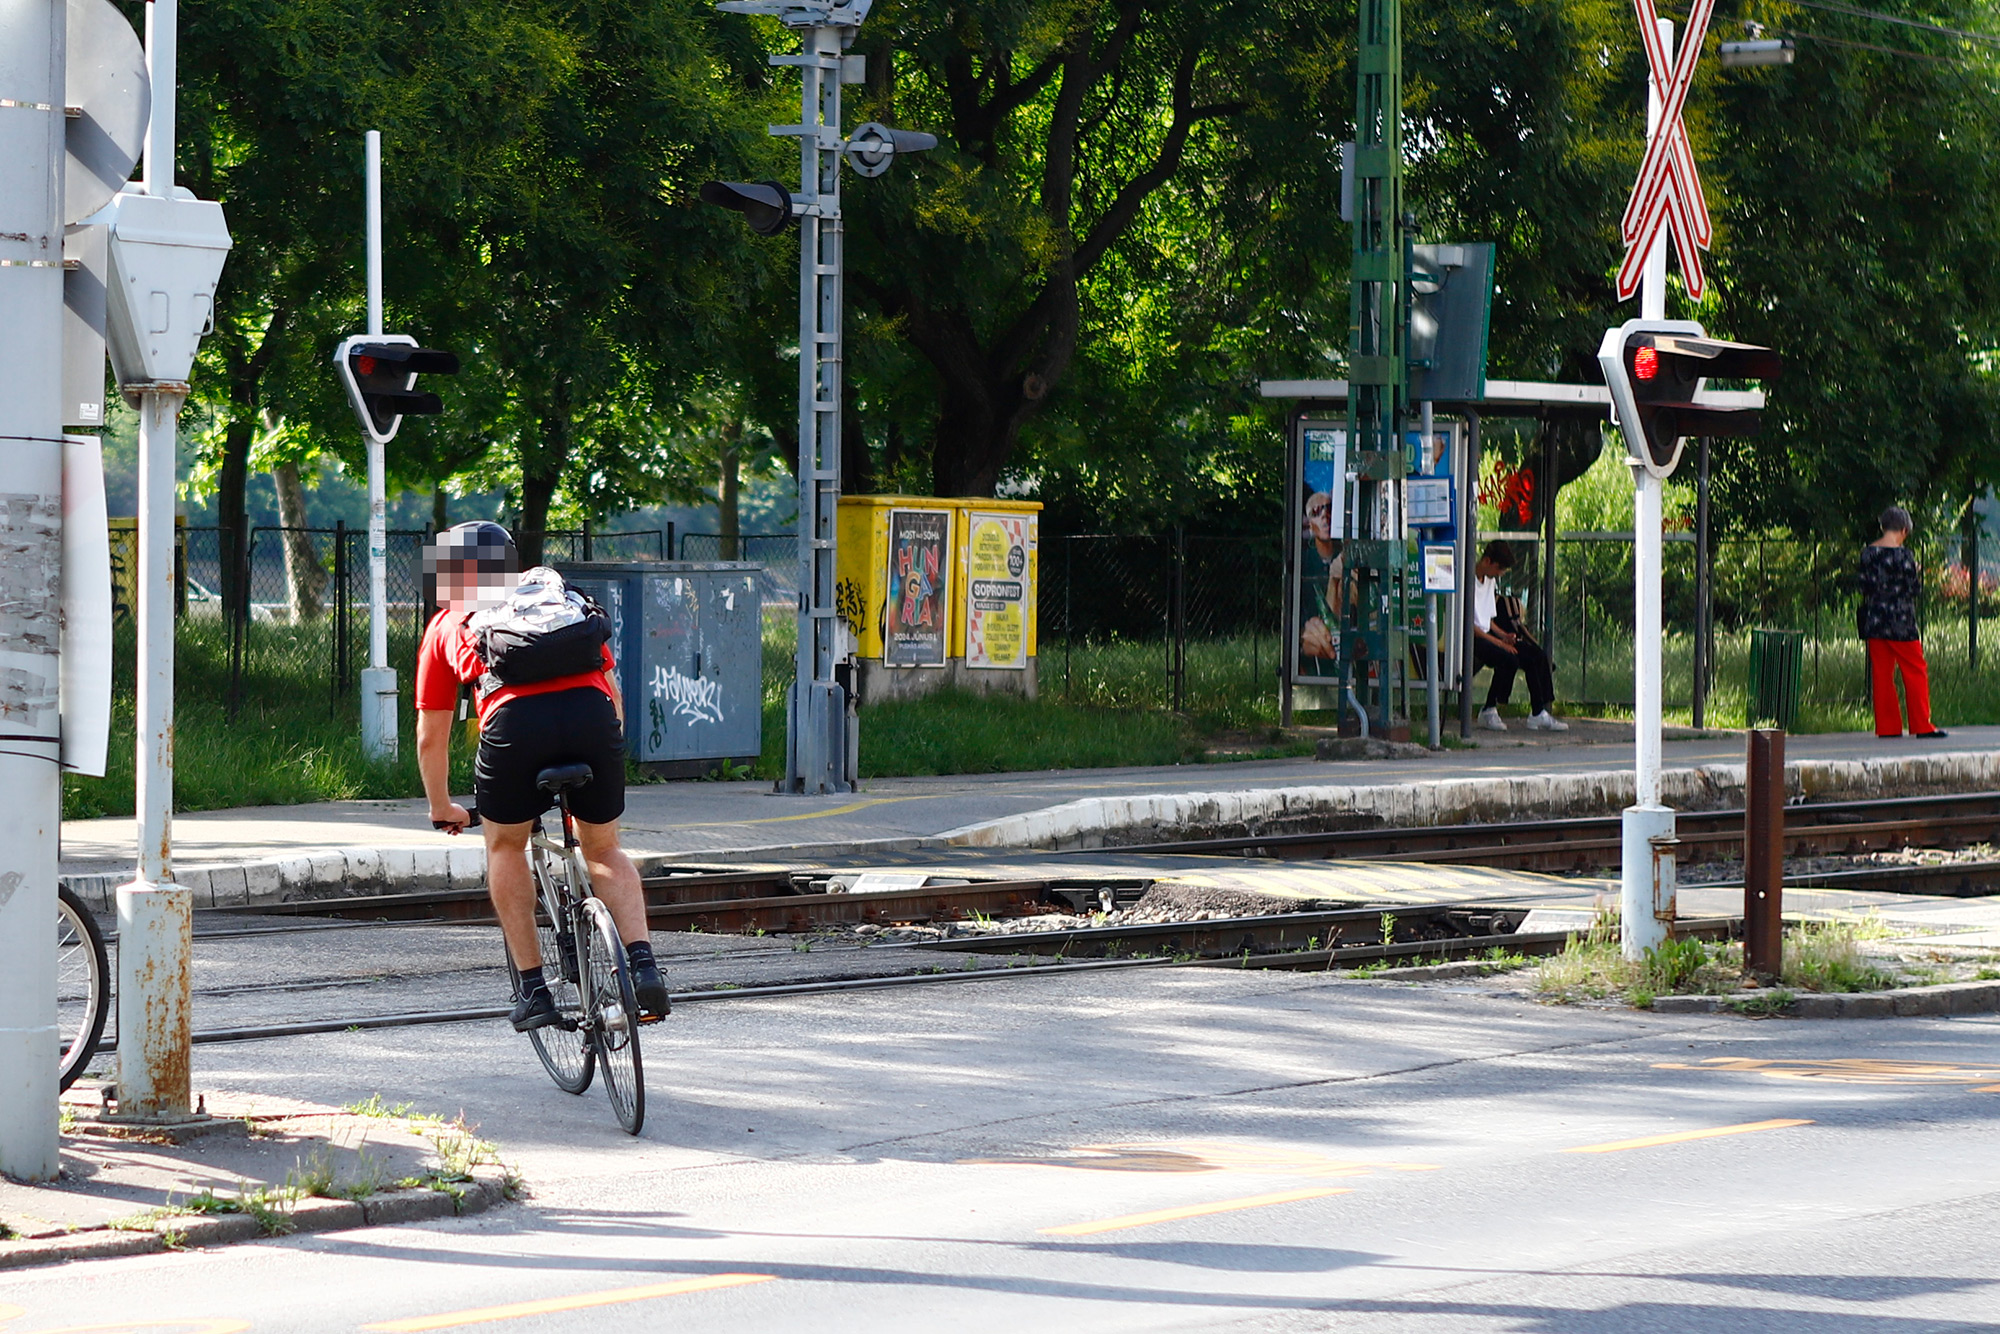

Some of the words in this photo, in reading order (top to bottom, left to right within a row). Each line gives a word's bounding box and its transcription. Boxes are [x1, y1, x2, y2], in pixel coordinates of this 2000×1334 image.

[899, 530, 916, 540] MOST
[1009, 555, 1023, 567] 100+
[974, 583, 1020, 598] SOPRONFEST
